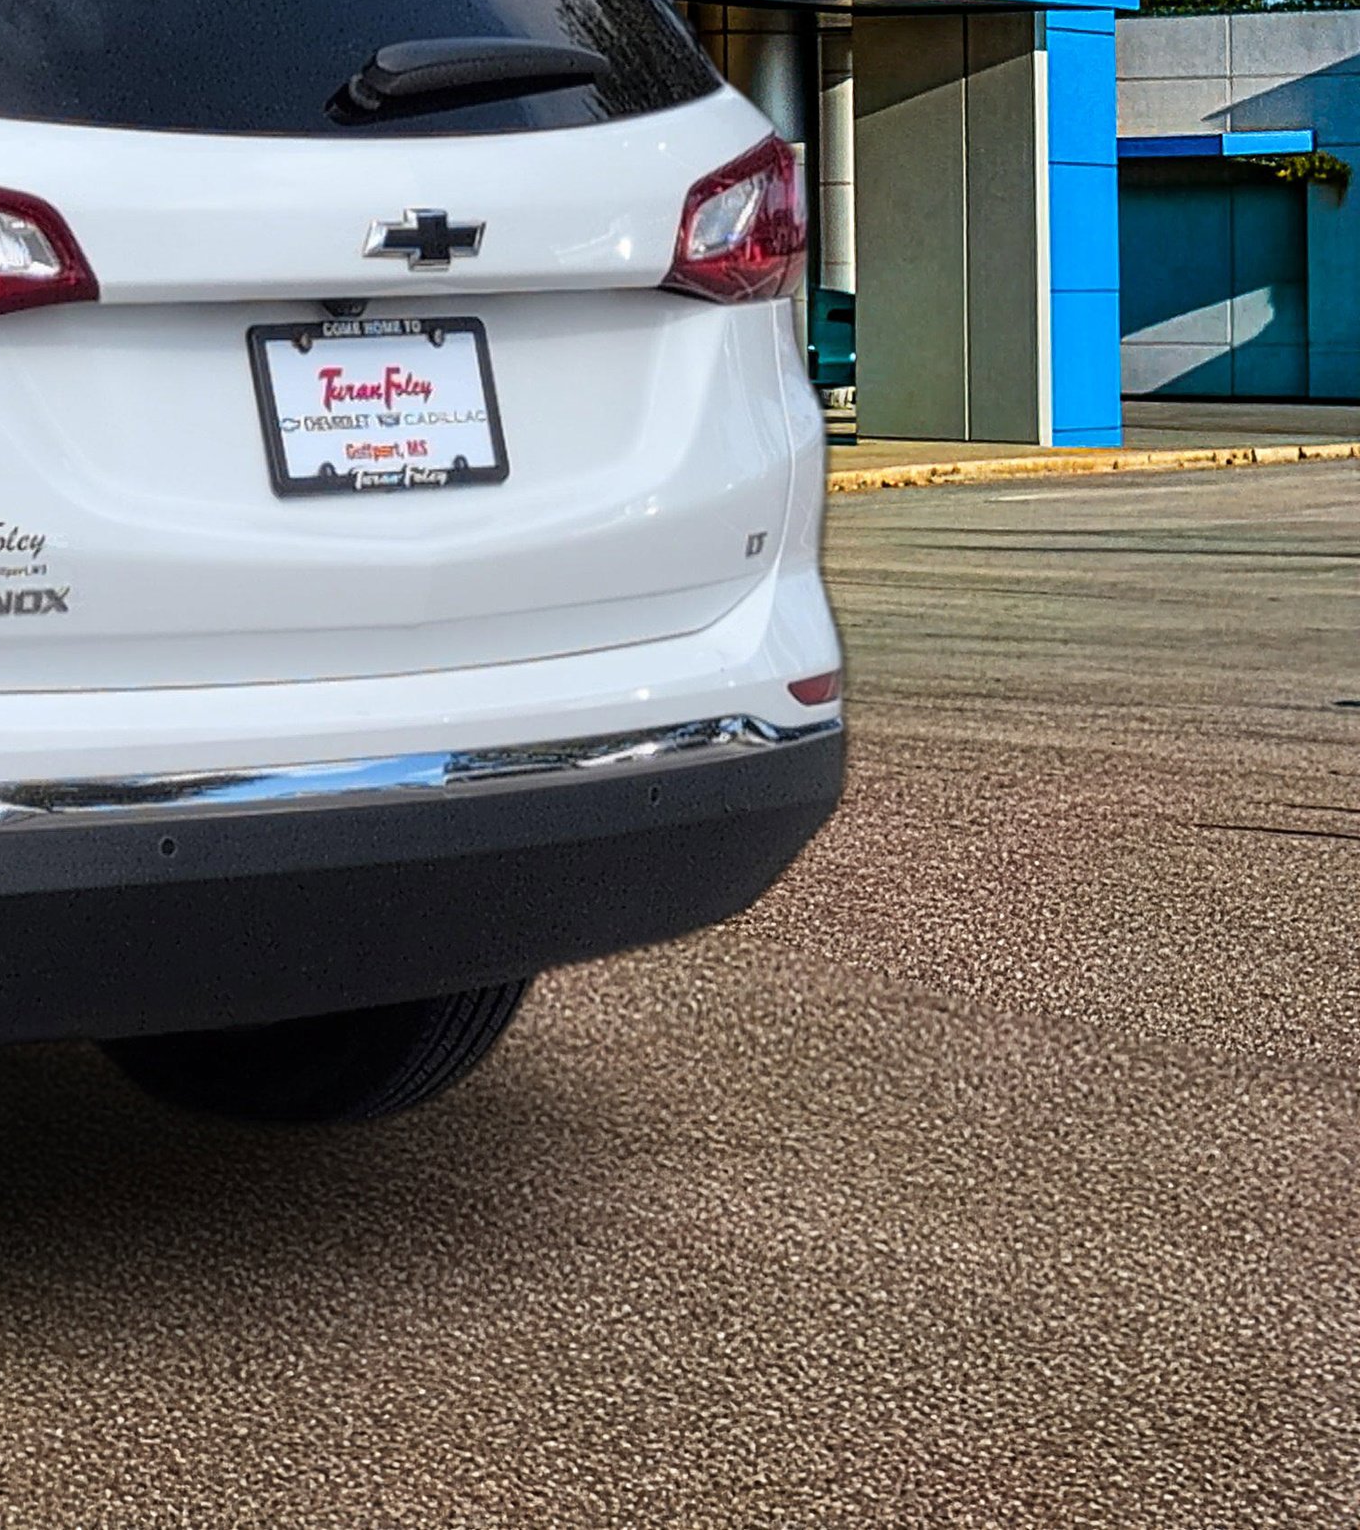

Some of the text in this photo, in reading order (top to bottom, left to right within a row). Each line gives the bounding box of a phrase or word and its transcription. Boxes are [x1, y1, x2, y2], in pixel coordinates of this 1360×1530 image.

[322, 322, 361, 336] COME
[405, 320, 421, 333] TO
[304, 410, 487, 431] CHEVROLET CADILLAC
[745, 531, 768, 559] LT
